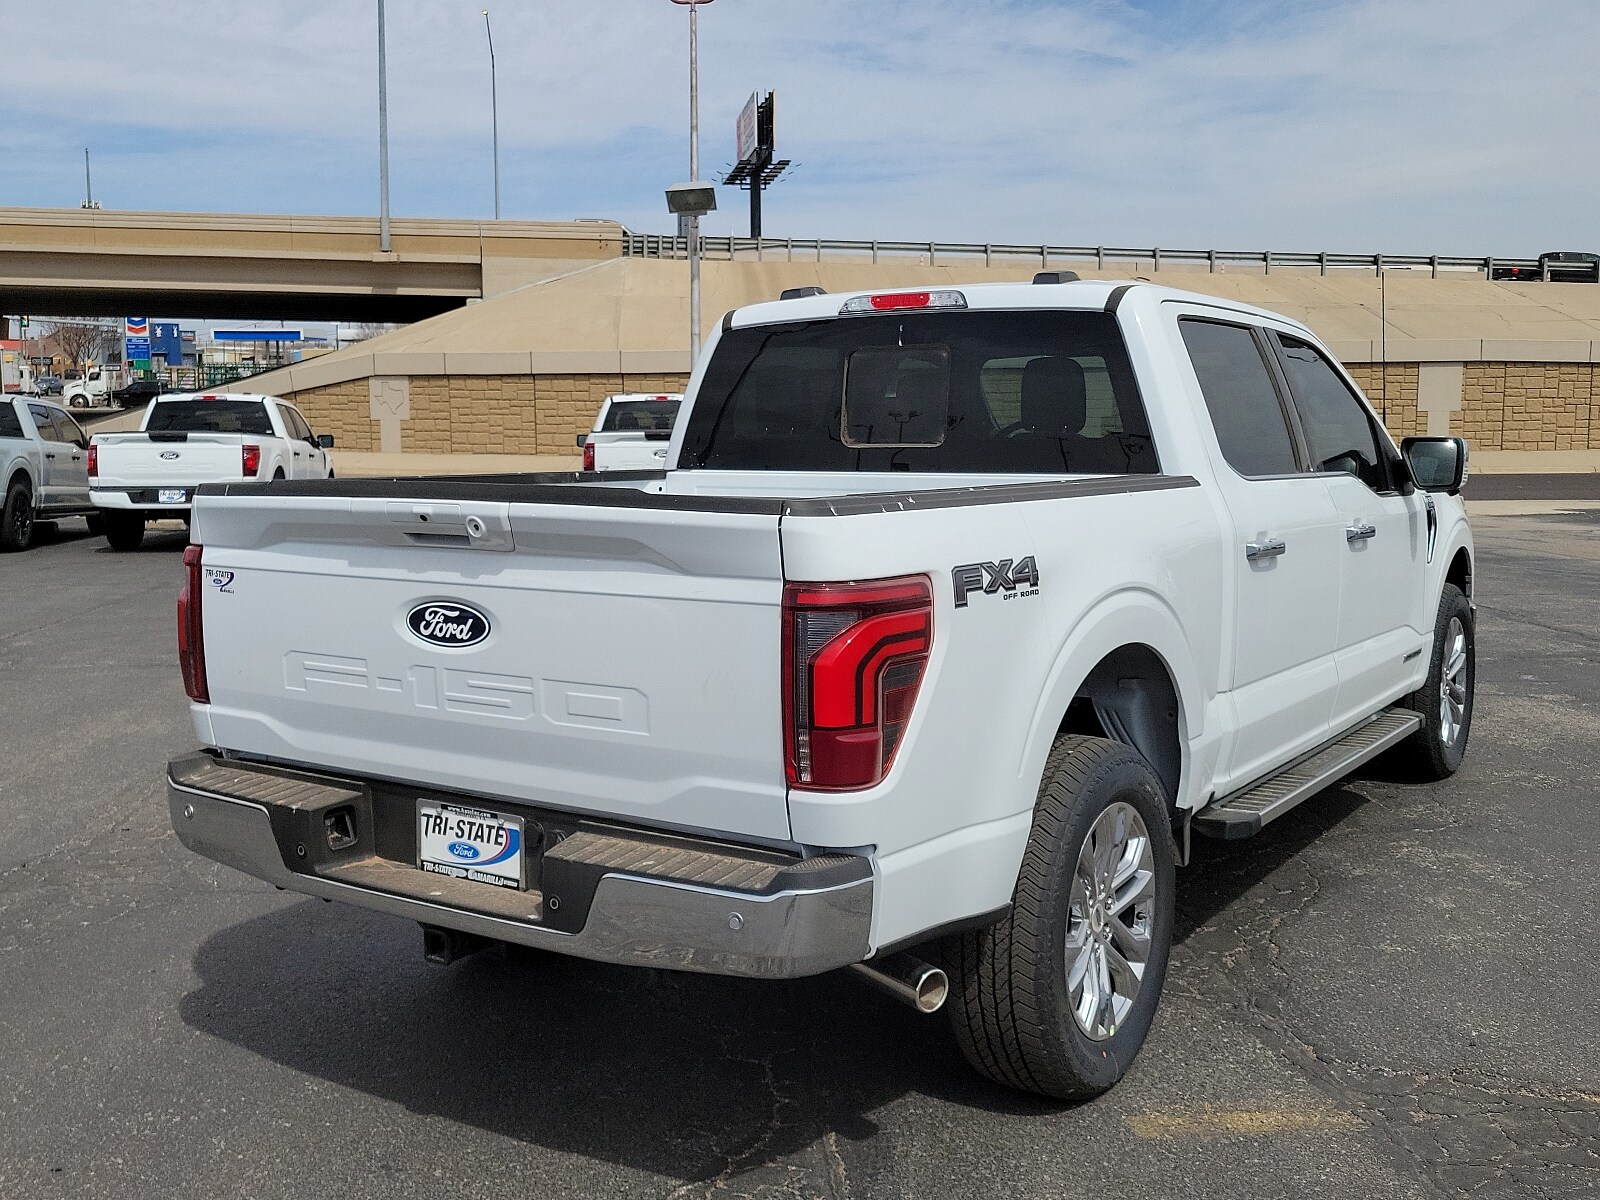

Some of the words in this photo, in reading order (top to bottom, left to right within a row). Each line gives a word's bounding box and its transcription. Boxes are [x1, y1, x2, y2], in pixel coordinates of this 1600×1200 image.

[205, 569, 231, 579] TRI-STATE
[951, 555, 1039, 609] FX4
[1003, 593, 1018, 601] OFF
[1020, 588, 1040, 598] ROAD
[419, 606, 474, 641] Ford
[282, 649, 651, 736] F-150
[421, 813, 505, 847] TRI-STATE
[453, 843, 474, 858] Ford
